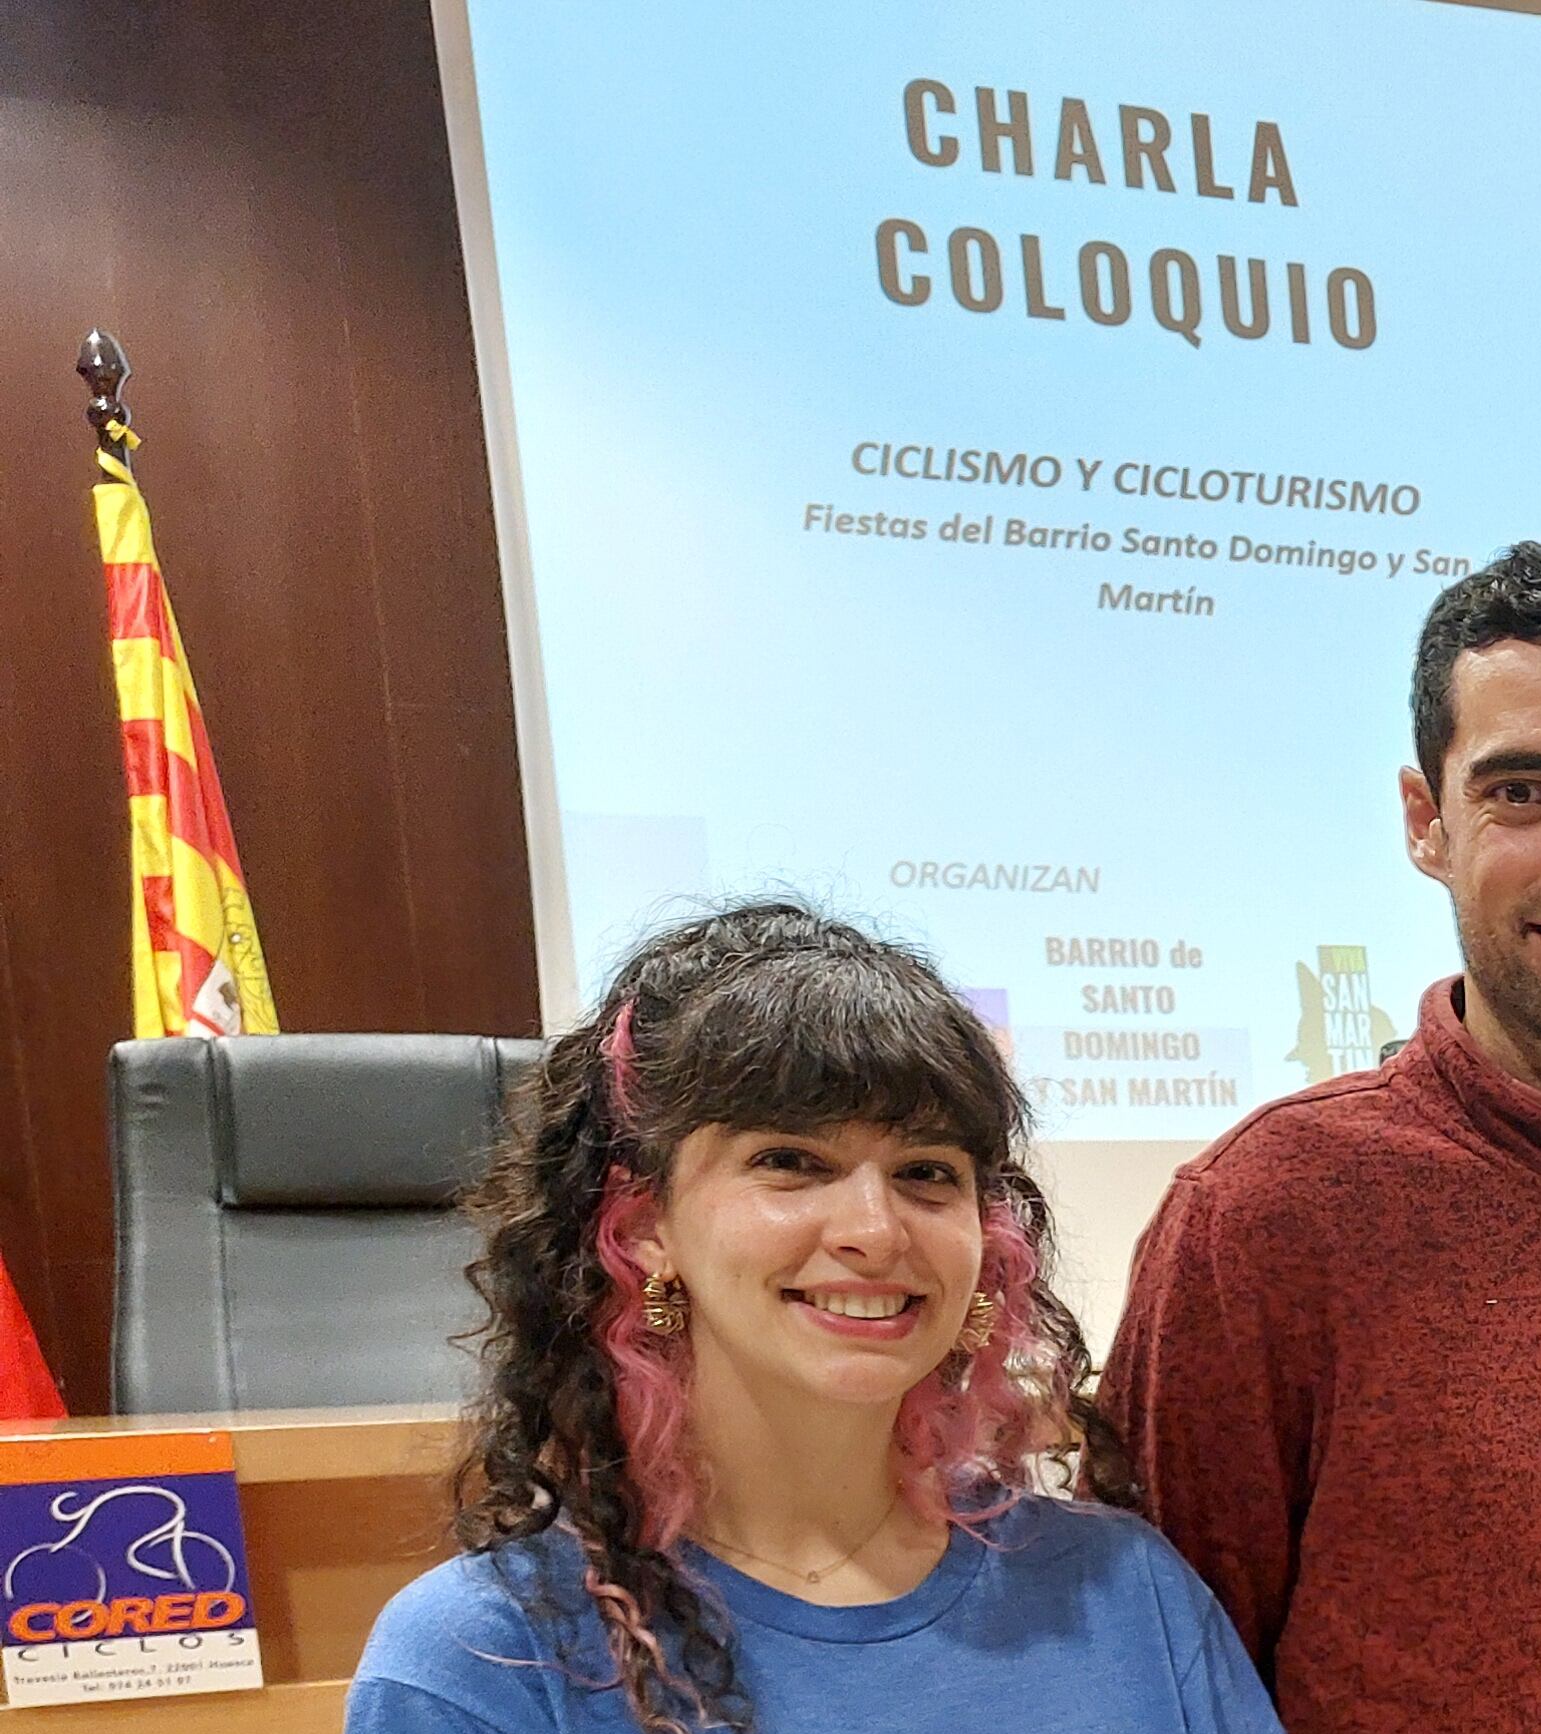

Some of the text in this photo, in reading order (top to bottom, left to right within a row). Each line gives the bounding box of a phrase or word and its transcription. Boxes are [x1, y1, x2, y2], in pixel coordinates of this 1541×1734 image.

[904, 79, 1299, 207] CHARLA
[875, 218, 1378, 351] COLOQUIO
[851, 440, 1420, 517] CICLISMO Y CICLOTURISMO
[802, 503, 1471, 580] Fiestas del Barrio Santo Domingo y San
[1098, 581, 1215, 617] Martín
[889, 859, 1101, 894] ORGANIZAN
[1045, 937, 1203, 968] BARRIO de
[1081, 984, 1176, 1014] SANTO
[1322, 973, 1369, 1011] SAN
[1063, 1031, 1201, 1061] DOMINGO
[1062, 1078, 1117, 1106] SAN
[1128, 1070, 1238, 1107] MARTÍN
[9, 1591, 245, 1641] CORED
[18, 1632, 245, 1662] CICLOS
